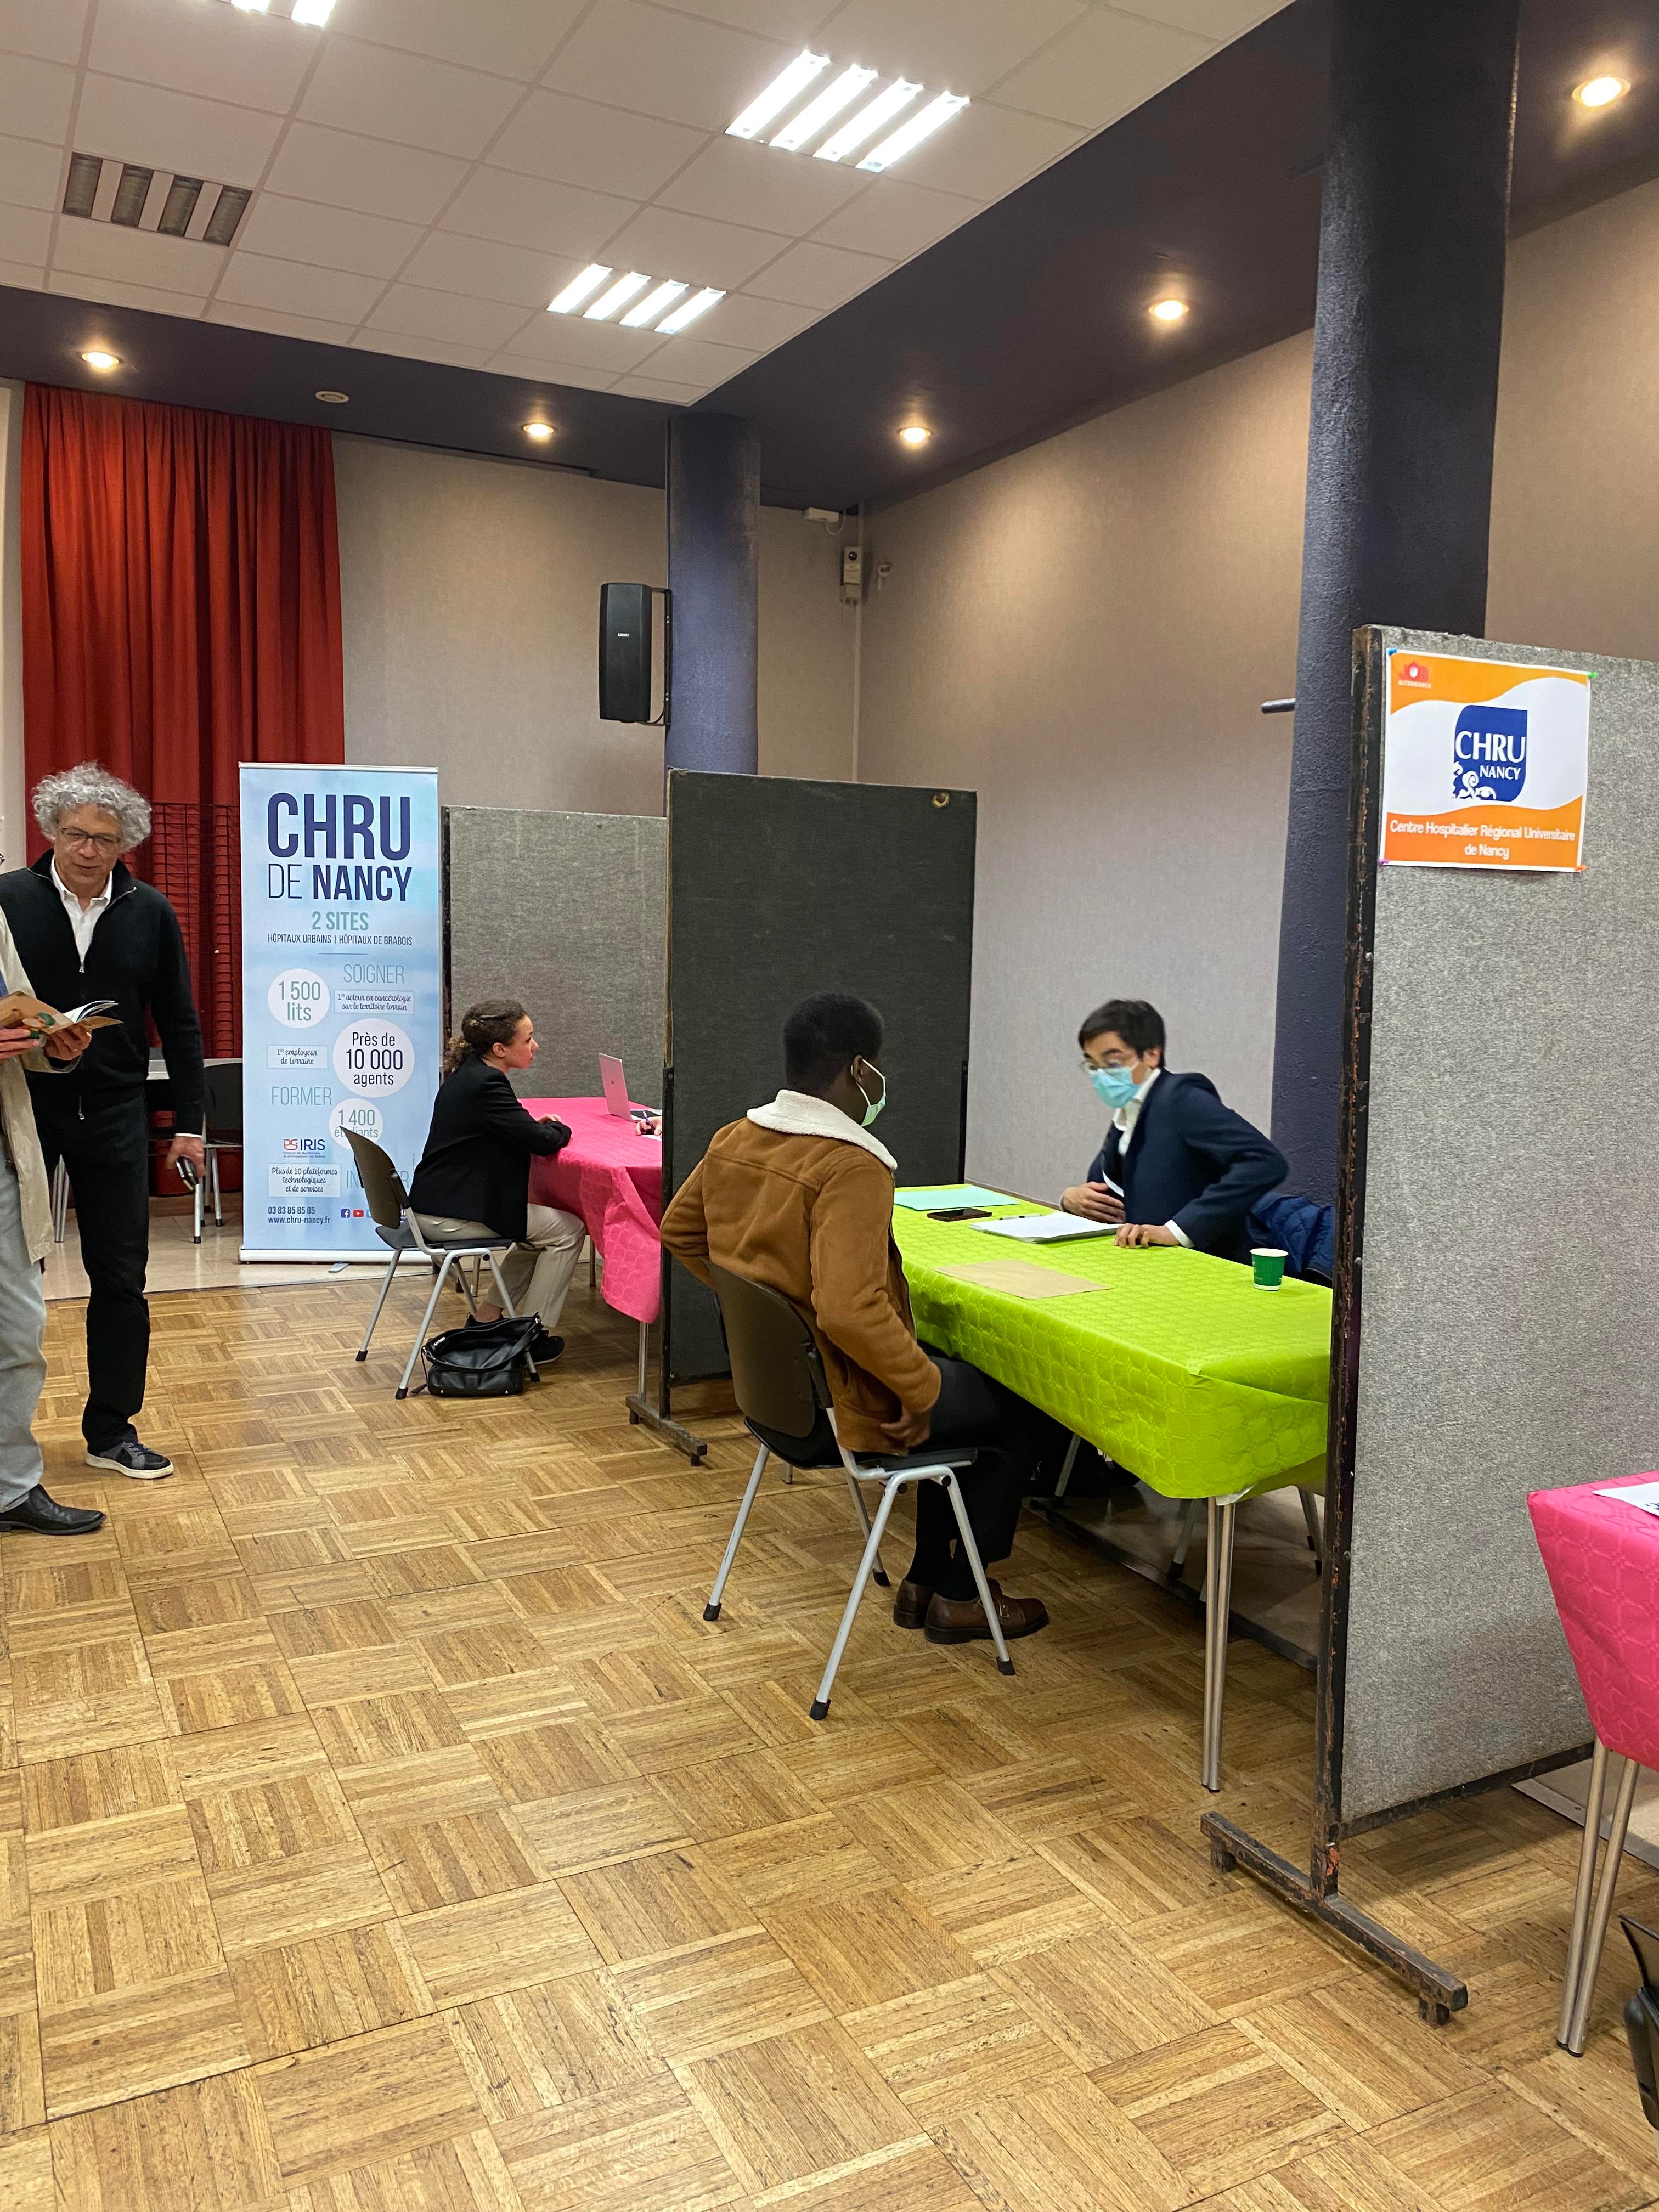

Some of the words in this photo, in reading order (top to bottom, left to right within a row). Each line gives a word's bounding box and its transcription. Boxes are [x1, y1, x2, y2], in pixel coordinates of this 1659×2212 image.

[1455, 731, 1525, 763] CHRU
[1480, 765, 1521, 780] NANCY
[268, 793, 410, 861] CHRU
[1390, 819, 1424, 834] Centre
[1425, 821, 1479, 839] Hospitalier
[1480, 824, 1522, 841] Régional
[1523, 827, 1576, 841] Universitaire
[1464, 843, 1477, 856] de
[1479, 843, 1509, 861] Nancy
[268, 864, 302, 899] DE
[313, 864, 413, 901] NANCY
[312, 911, 321, 930] 2
[326, 911, 369, 931] SITES
[268, 933, 301, 943] HÔPITAUX
[302, 934, 332, 944] URBAINS
[339, 934, 371, 945] HÔPITAUX
[374, 936, 382, 945] DE
[383, 936, 413, 946] BRABOIS
[343, 964, 405, 984] SOIGNER
[279, 981, 285, 1000] 1
[291, 981, 321, 1001] 500
[374, 994, 411, 1003] cancérologie
[287, 1002, 312, 1021] lits
[353, 1002, 359, 1010] le
[386, 1002, 407, 1011] lorrain
[352, 1032, 377, 1047] Près
[381, 1032, 396, 1047] de
[285, 1048, 318, 1057] employeur
[346, 1049, 364, 1070] 10
[370, 1049, 403, 1070] 000
[354, 1072, 394, 1087] agents
[272, 1086, 332, 1106] FORMER
[338, 1109, 343, 1125] 1
[349, 1109, 375, 1126] 400
[300, 1139, 325, 1151] IRIS
[303, 1167, 337, 1176] plateformes
[283, 1176, 326, 1185] technologiques
[287, 1206, 296, 1215] 85
[268, 1215, 330, 1224] www.chru-nancy.fr
